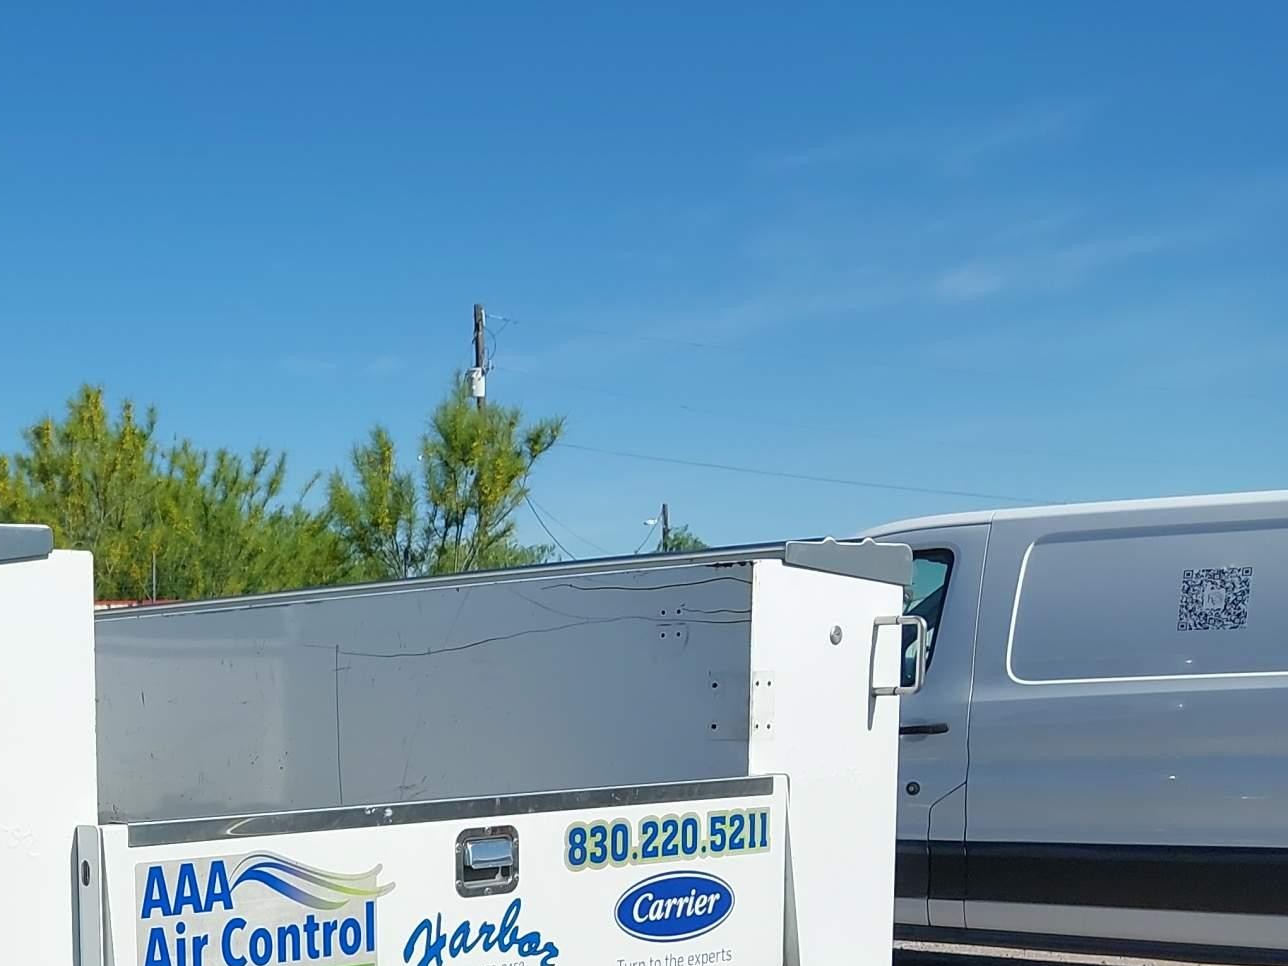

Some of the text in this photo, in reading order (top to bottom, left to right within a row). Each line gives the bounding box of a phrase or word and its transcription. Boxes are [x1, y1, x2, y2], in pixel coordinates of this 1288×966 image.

[568, 812, 769, 867] 830.220.5211
[141, 860, 233, 919] AAA
[632, 889, 721, 923] Carrier
